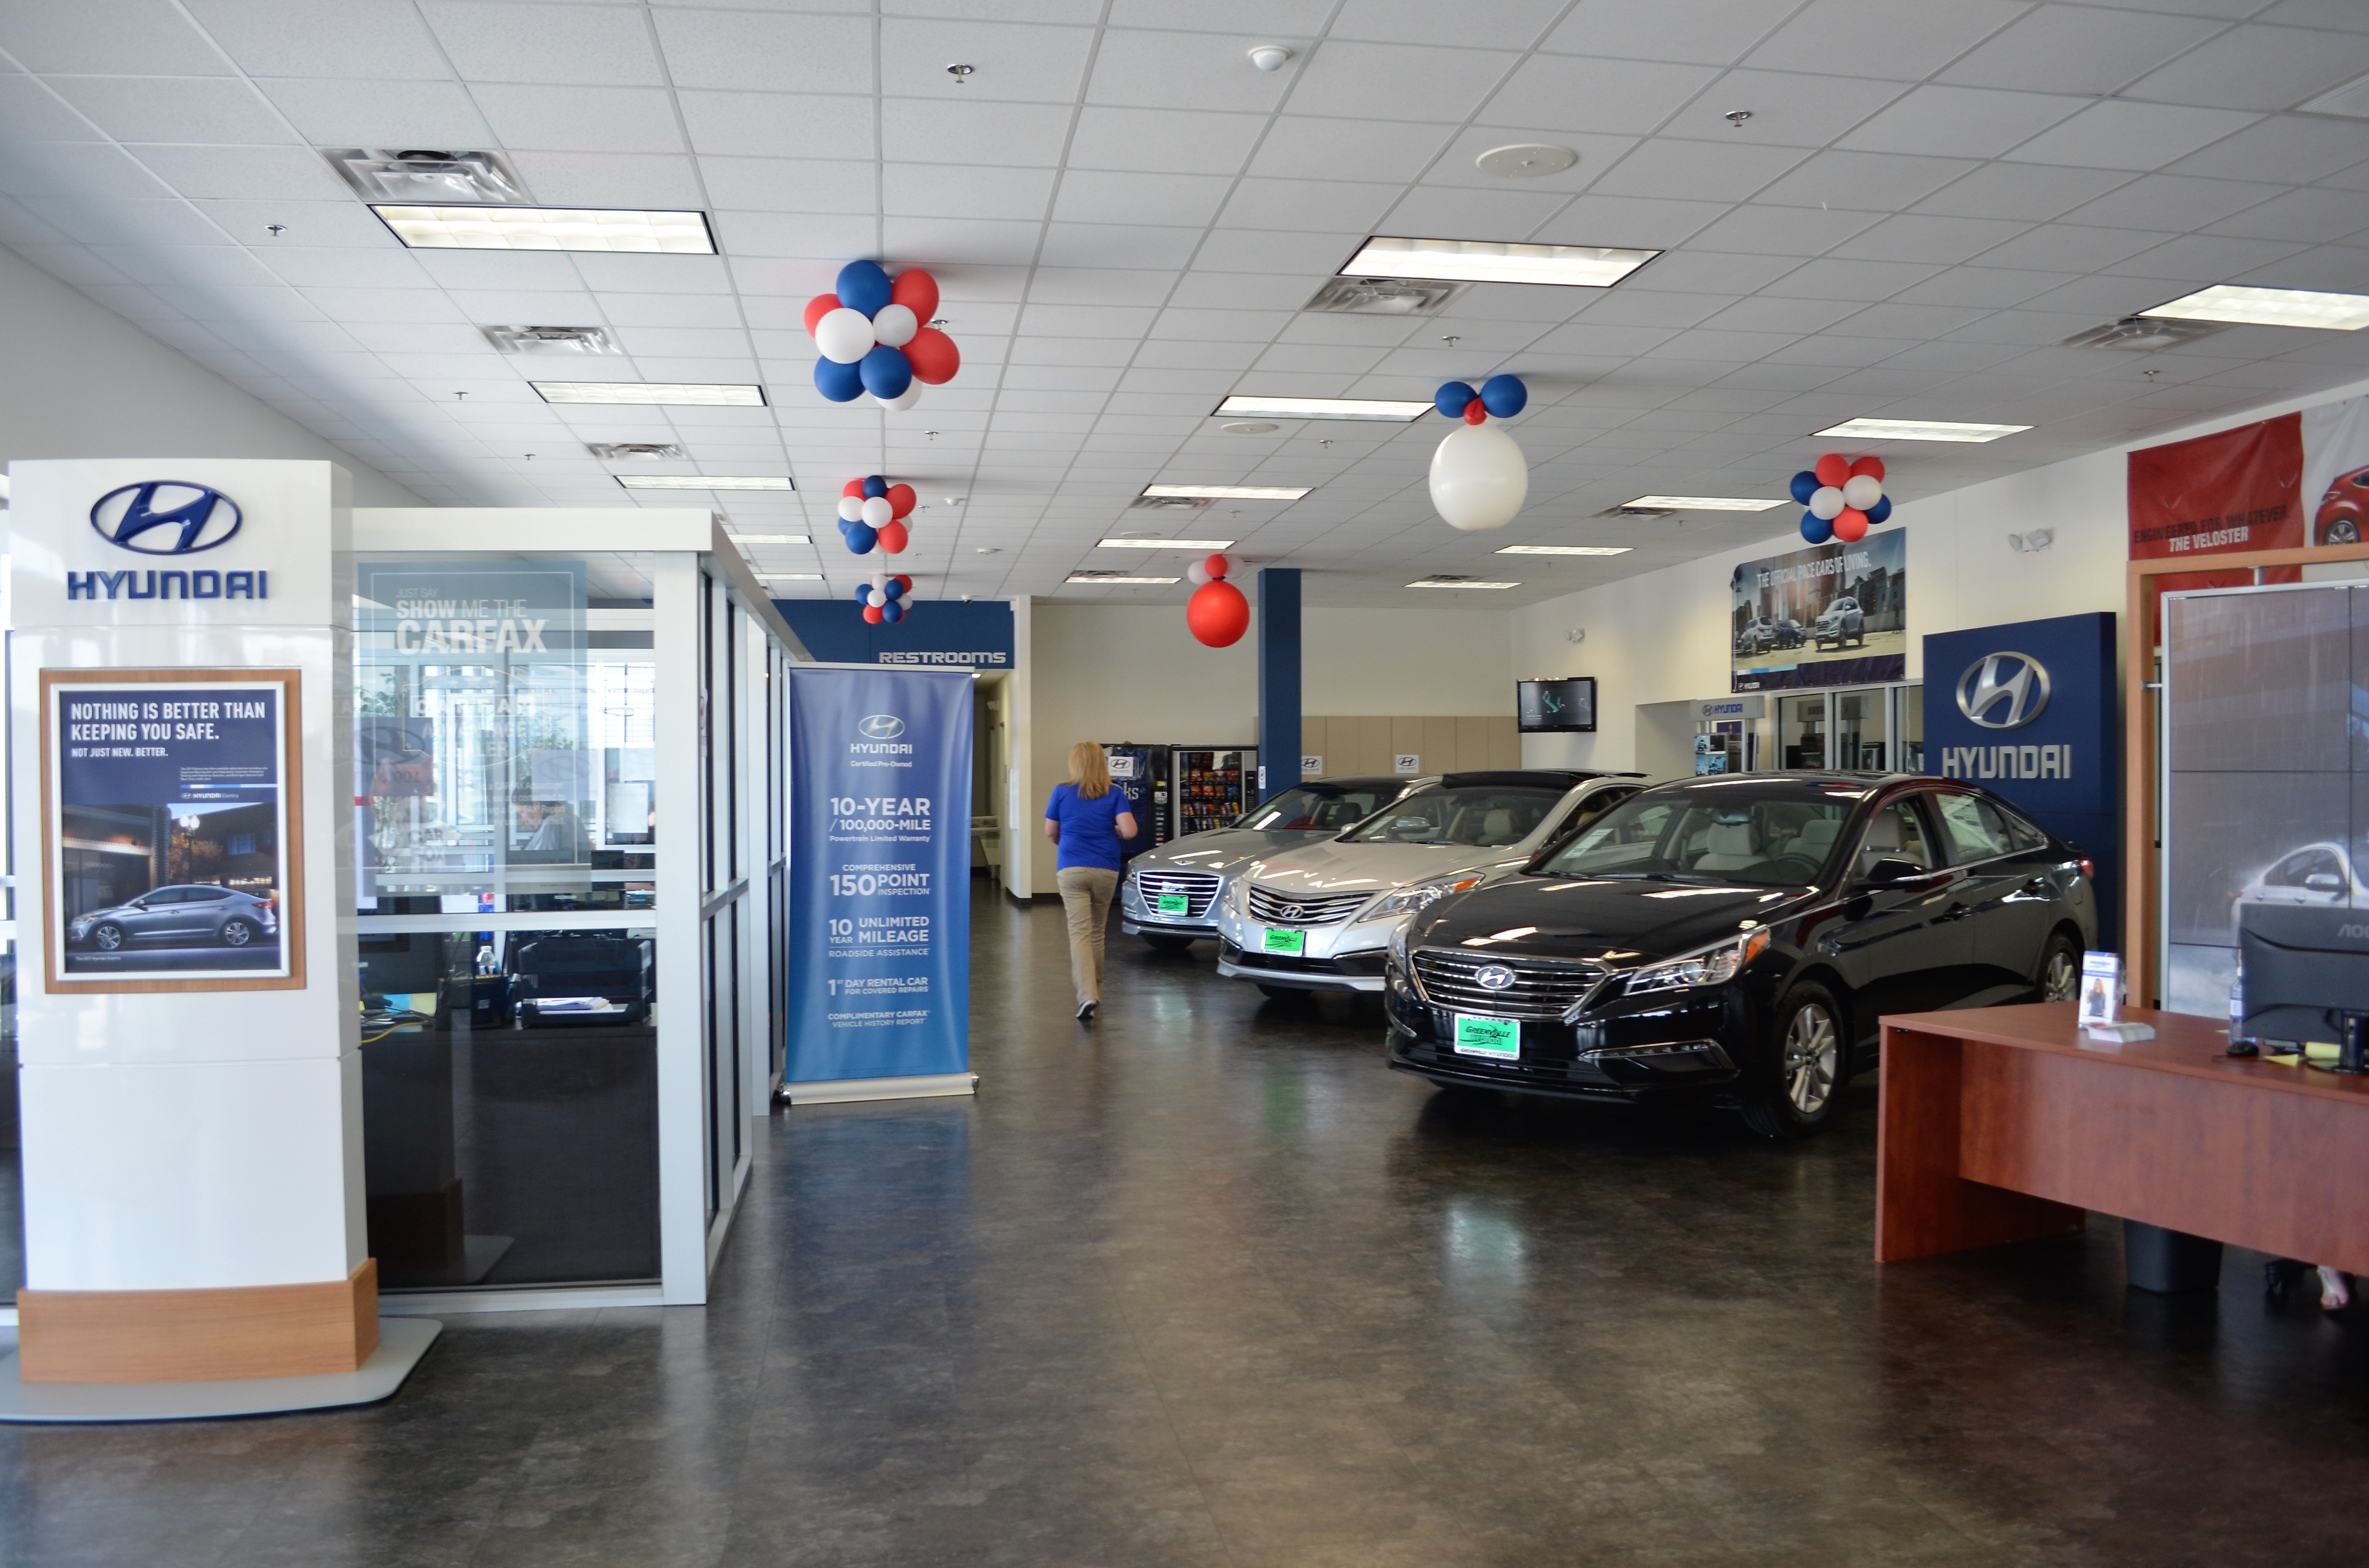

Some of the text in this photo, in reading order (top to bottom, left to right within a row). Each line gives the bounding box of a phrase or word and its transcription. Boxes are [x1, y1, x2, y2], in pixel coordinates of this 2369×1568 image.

[2134, 521, 2197, 544] ENGINEERED
[2200, 516, 2222, 533] FOR
[2169, 526, 2249, 552] THE VELOSTER
[1757, 551, 1871, 588] THE OFFICIAL PACE CARS OF LIVING.
[67, 569, 267, 599] HYUNDAI
[396, 588, 438, 598] JUST SAY
[396, 599, 527, 618] SHOW ME THE
[396, 619, 548, 655] CARFAX
[879, 652, 1006, 663] RESTROOMS
[71, 702, 265, 720] NOTHING IS BETTER THAN
[1714, 704, 1743, 714] HYUNDAI
[71, 723, 219, 741] KEEPING YOU SAFE.
[71, 747, 168, 757] NOT JUST NEW. BETTER.
[850, 743, 913, 754] HYUNDAI
[1942, 744, 2071, 778] HYUNDAI
[496, 781, 524, 790] CARAX
[830, 797, 931, 816] 10-YEAR
[840, 819, 931, 832] 100,000-MILE
[830, 873, 930, 896] 150 POINT
[829, 916, 930, 936] 10 UNLIMITED
[859, 930, 929, 943] MILEAGE
[877, 948, 929, 956] ASSISTANCE
[845, 979, 865, 987] DAY
[867, 978, 905, 986] RENTAL
[907, 977, 928, 985] CAR
[828, 1011, 895, 1020] COMPLIMENTARY
